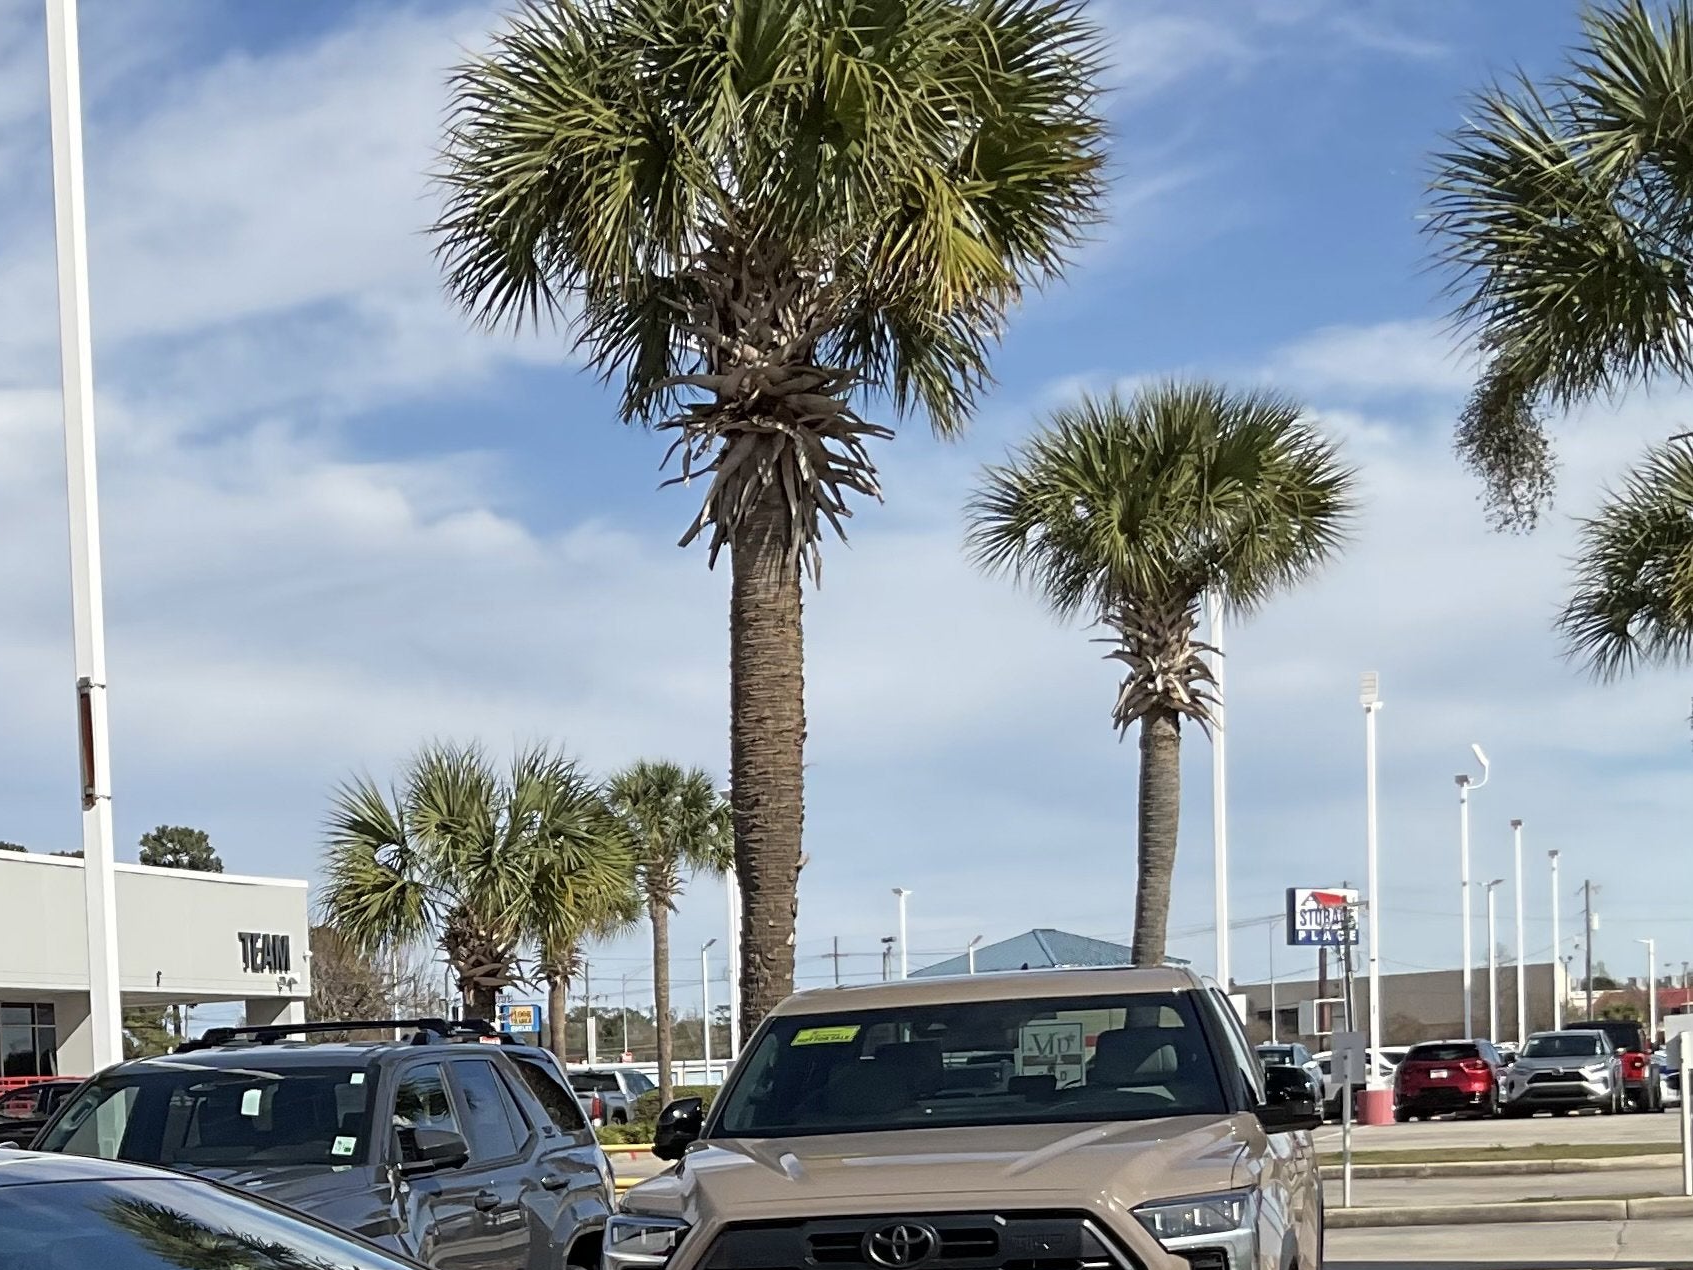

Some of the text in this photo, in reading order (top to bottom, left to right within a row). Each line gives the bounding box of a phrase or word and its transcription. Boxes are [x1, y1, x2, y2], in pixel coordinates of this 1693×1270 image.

[1300, 908, 1356, 928] STORAE
[1298, 930, 1356, 941] PLACE
[238, 932, 291, 973] TEAM
